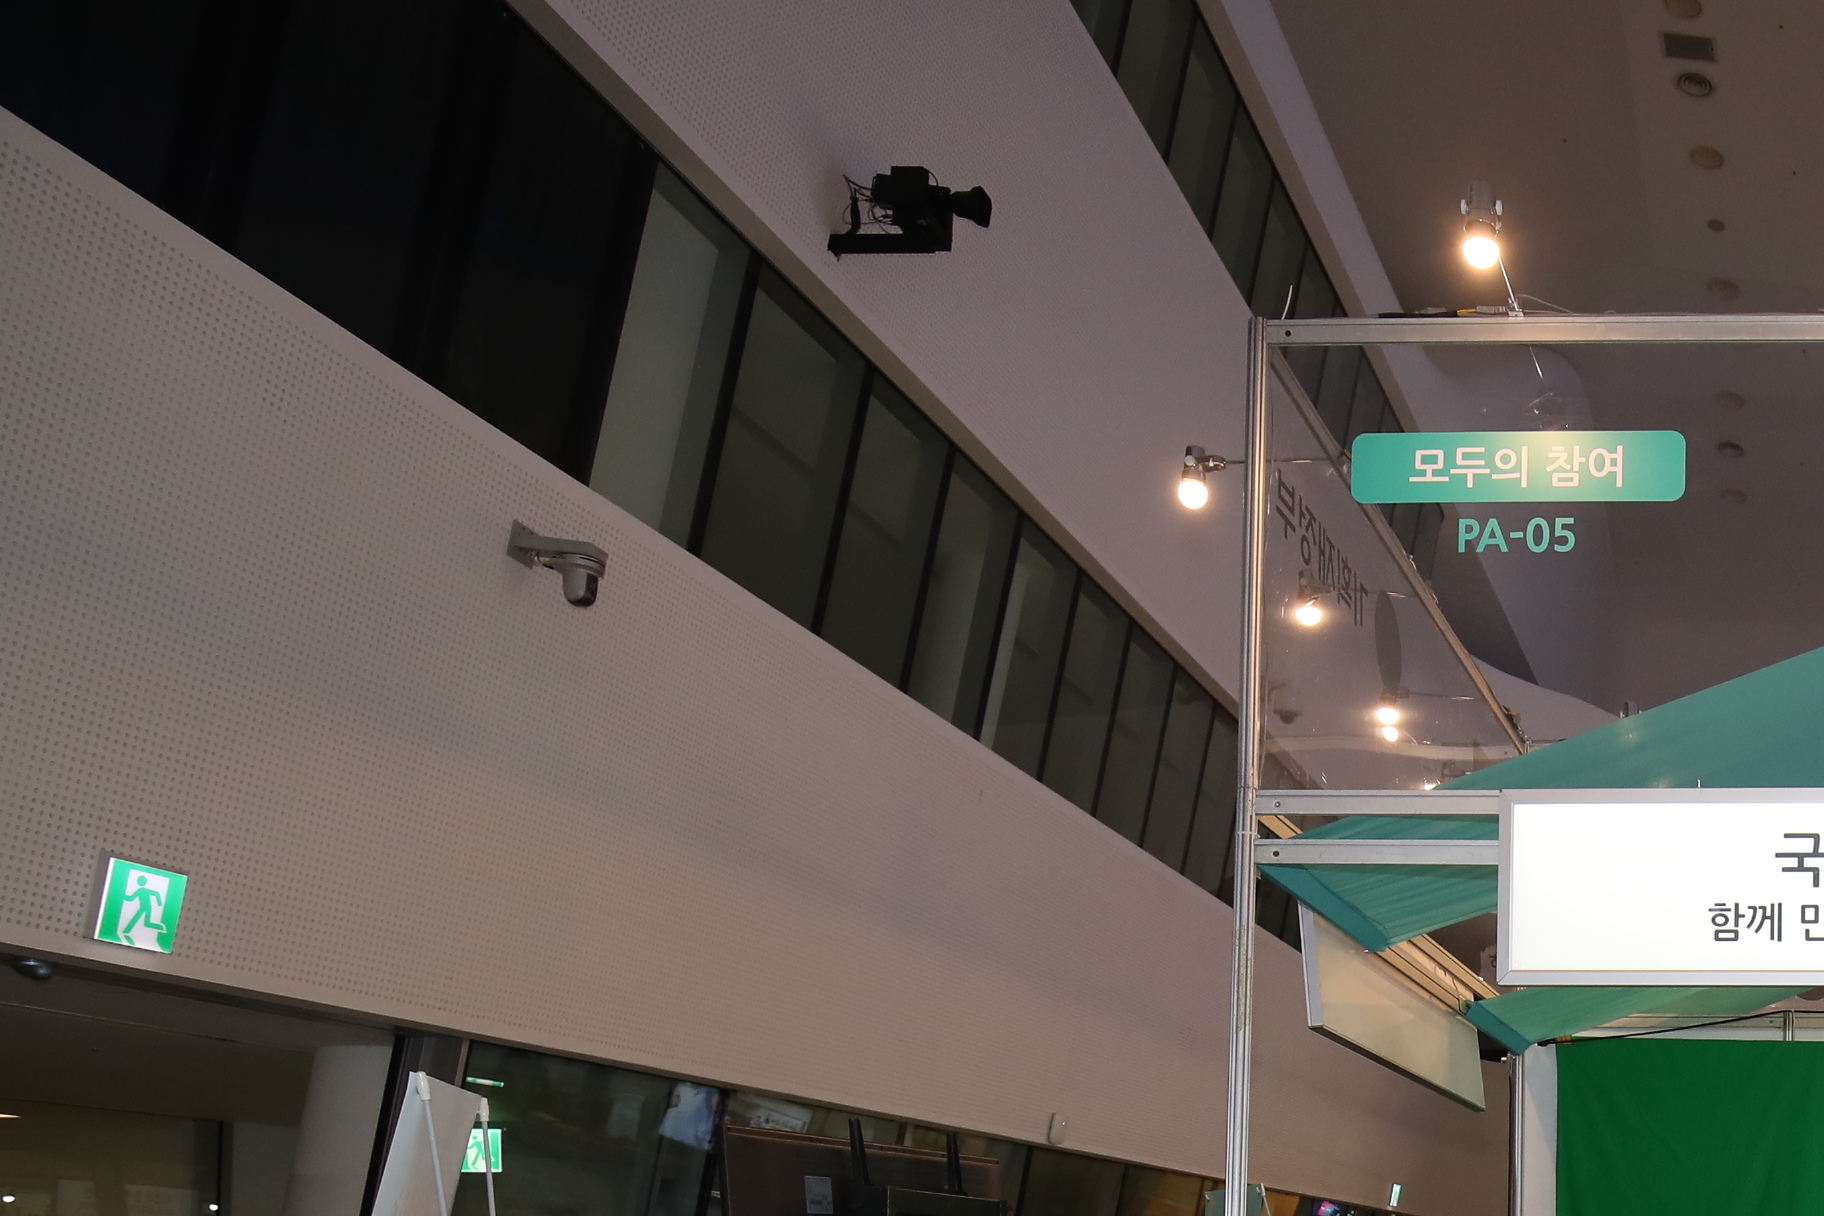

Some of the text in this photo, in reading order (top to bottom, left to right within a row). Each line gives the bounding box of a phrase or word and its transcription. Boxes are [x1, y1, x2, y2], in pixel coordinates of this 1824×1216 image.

[1408, 445, 1625, 489] 모두의 참여
[1457, 517, 1577, 554] PA-05
[1708, 901, 1784, 944] 함께
